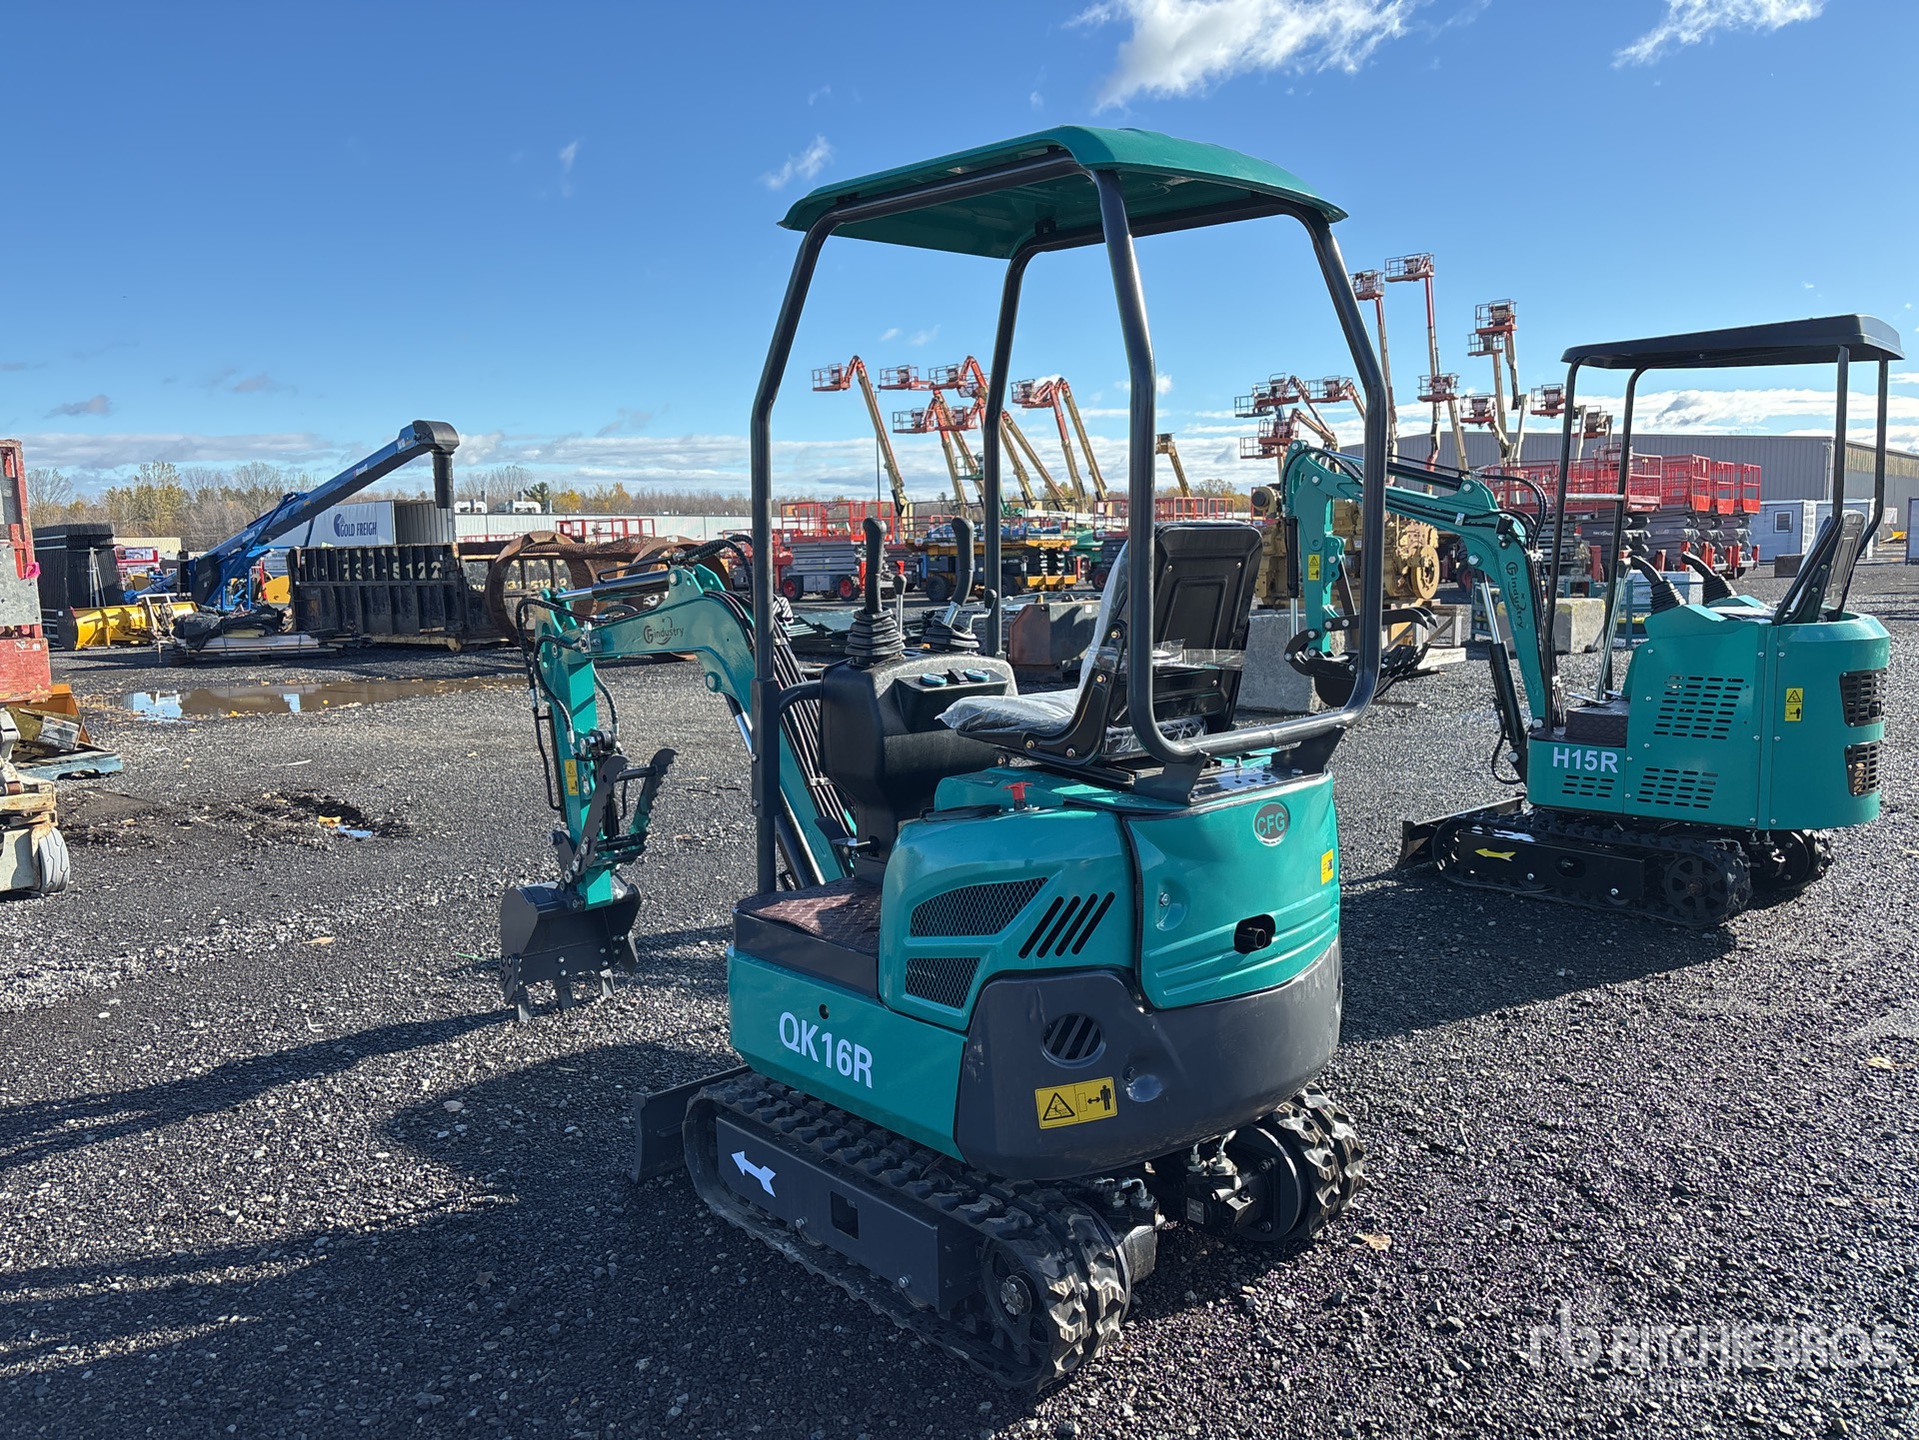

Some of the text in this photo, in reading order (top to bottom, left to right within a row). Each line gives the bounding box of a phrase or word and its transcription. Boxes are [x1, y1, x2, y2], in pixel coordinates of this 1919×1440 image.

[1552, 746, 1618, 774] H15R
[1257, 812, 1285, 836] CFG
[779, 1011, 873, 1089] QK16R
